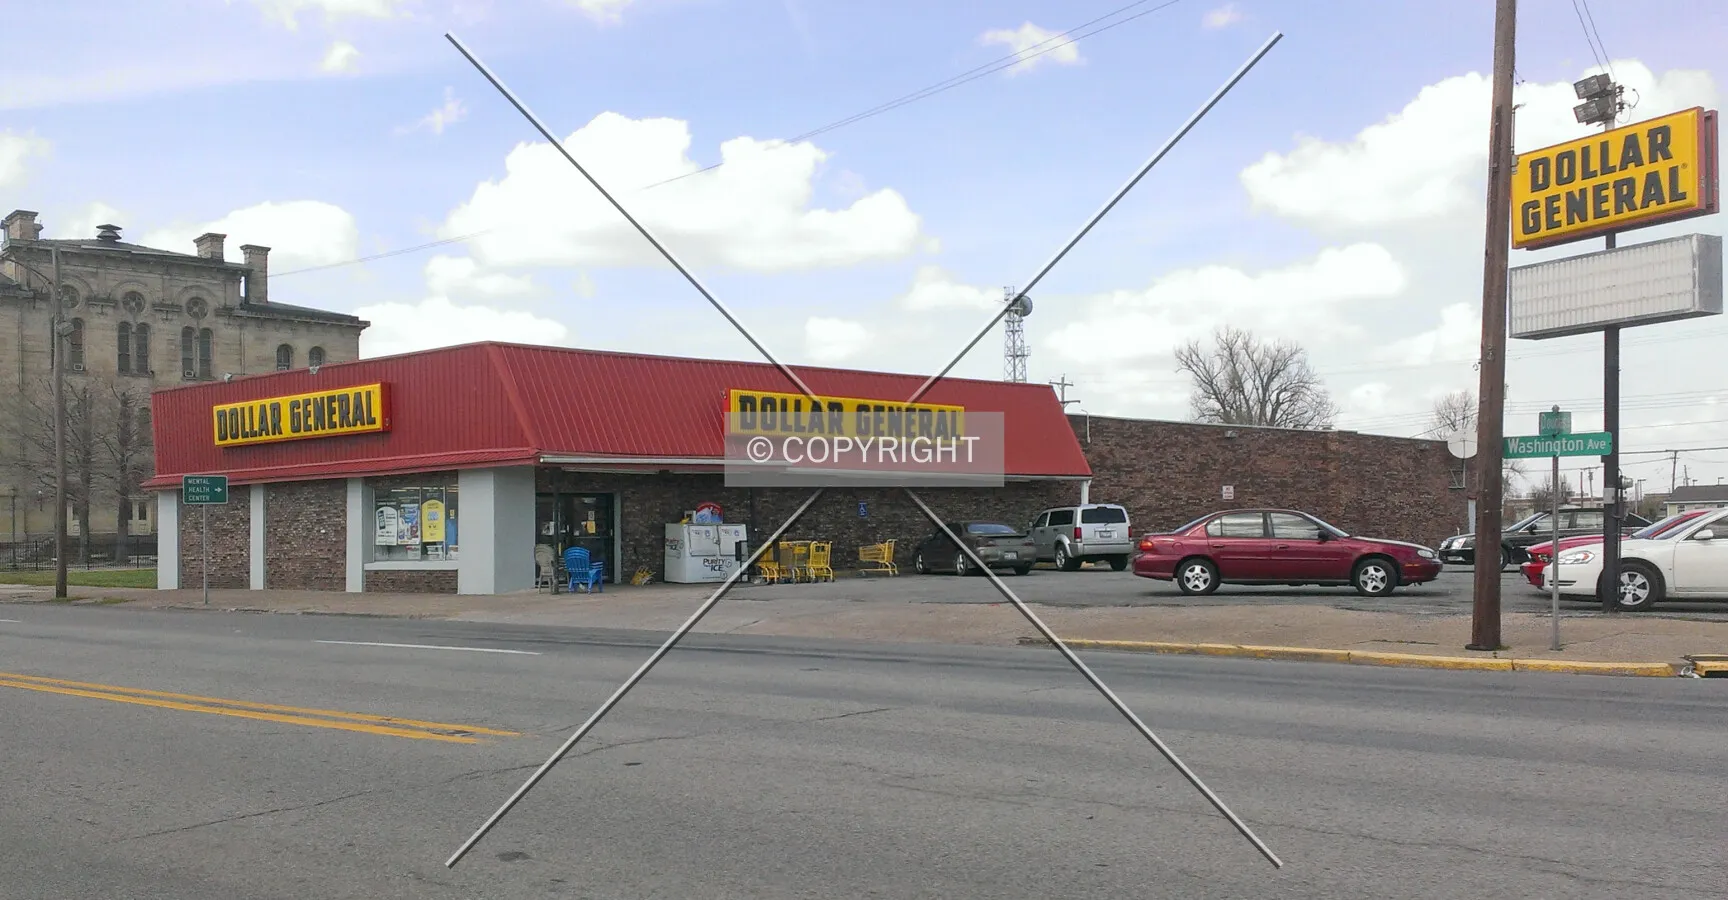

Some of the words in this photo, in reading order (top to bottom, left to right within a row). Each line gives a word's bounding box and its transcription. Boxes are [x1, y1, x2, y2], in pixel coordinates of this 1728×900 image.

[1529, 124, 1674, 193] DOLLAR
[1520, 165, 1687, 235] GENERAL
[216, 401, 283, 441] DOLLAR
[289, 390, 376, 433] GENERAL
[738, 395, 845, 435] DOLLAR
[855, 403, 961, 440] GENERAL
[1507, 437, 1584, 457] Washington
[1587, 438, 1606, 450] Ave
